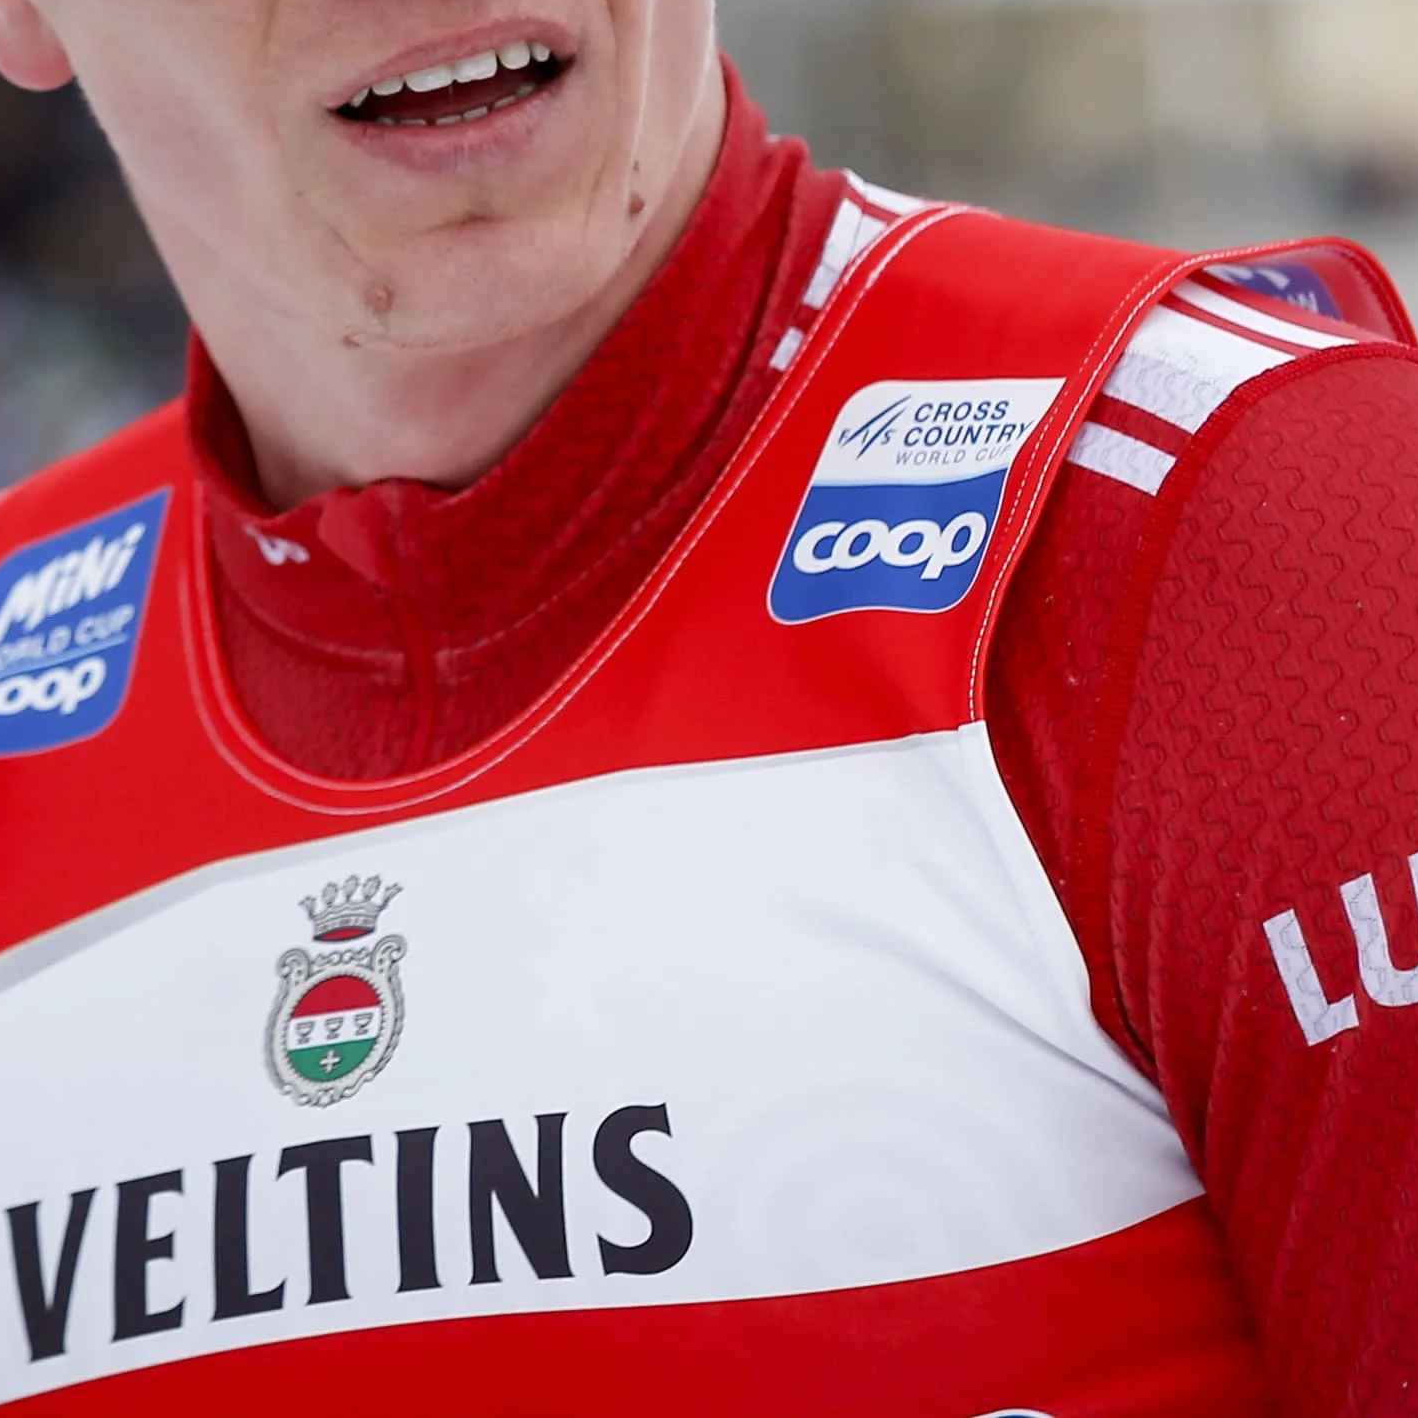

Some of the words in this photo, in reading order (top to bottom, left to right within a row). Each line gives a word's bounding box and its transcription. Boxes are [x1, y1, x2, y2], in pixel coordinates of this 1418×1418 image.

[914, 401, 1009, 423] CROSS
[904, 420, 1035, 447] COUNTRY
[896, 449, 966, 465] WORLD
[793, 511, 987, 580] coop
[74, 604, 135, 646] CUP
[5, 1102, 694, 1362] VELTINS
